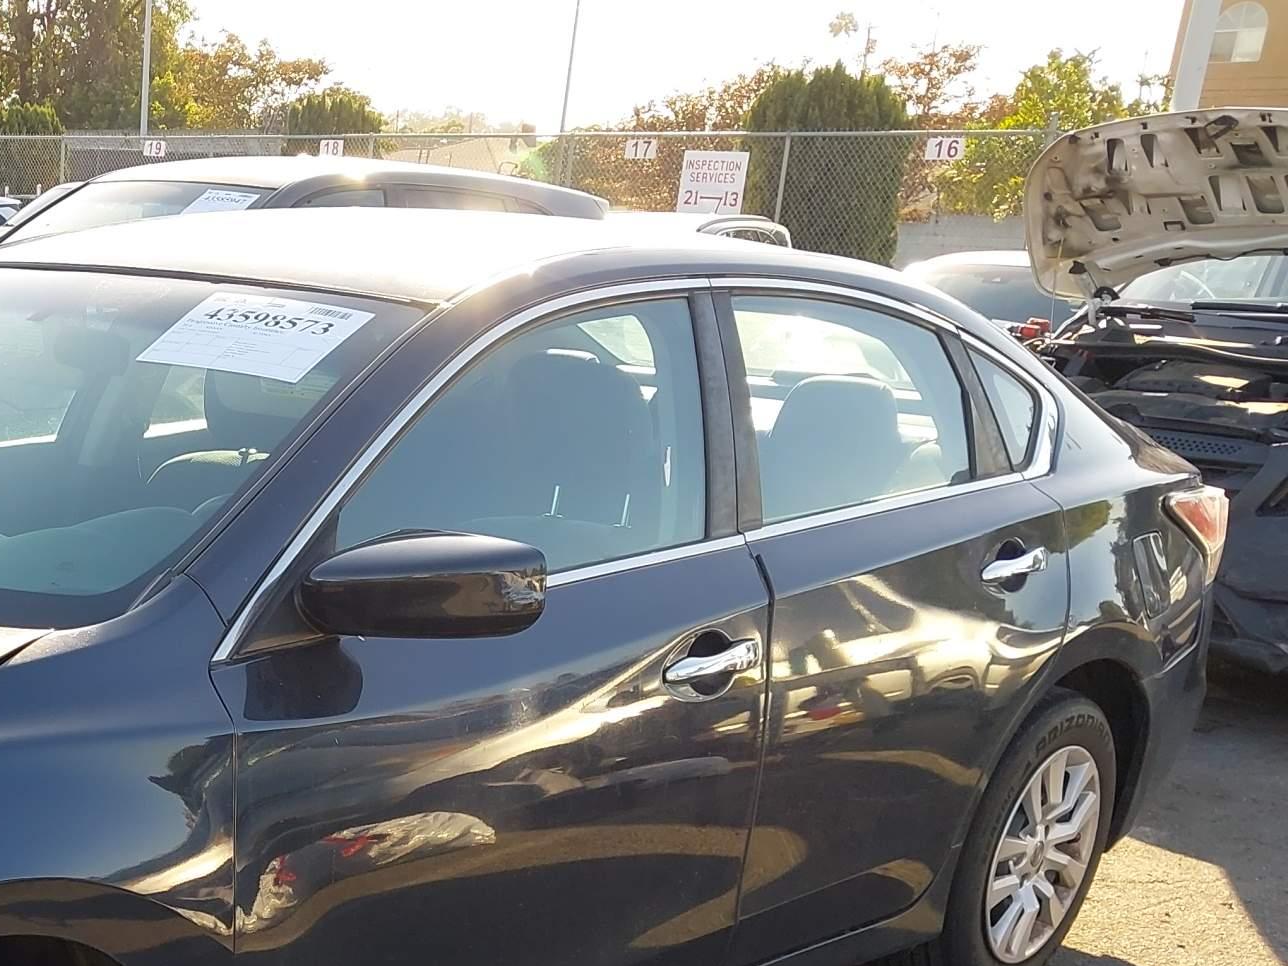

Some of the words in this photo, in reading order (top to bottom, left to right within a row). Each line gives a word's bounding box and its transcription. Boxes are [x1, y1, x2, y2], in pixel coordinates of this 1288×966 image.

[147, 141, 162, 156] 19
[323, 141, 339, 156] 18
[632, 141, 652, 158] 17
[935, 140, 960, 158] 16
[685, 160, 742, 172] INSPECTION
[689, 172, 736, 183] SERVICES
[204, 307, 335, 336] 43598573
